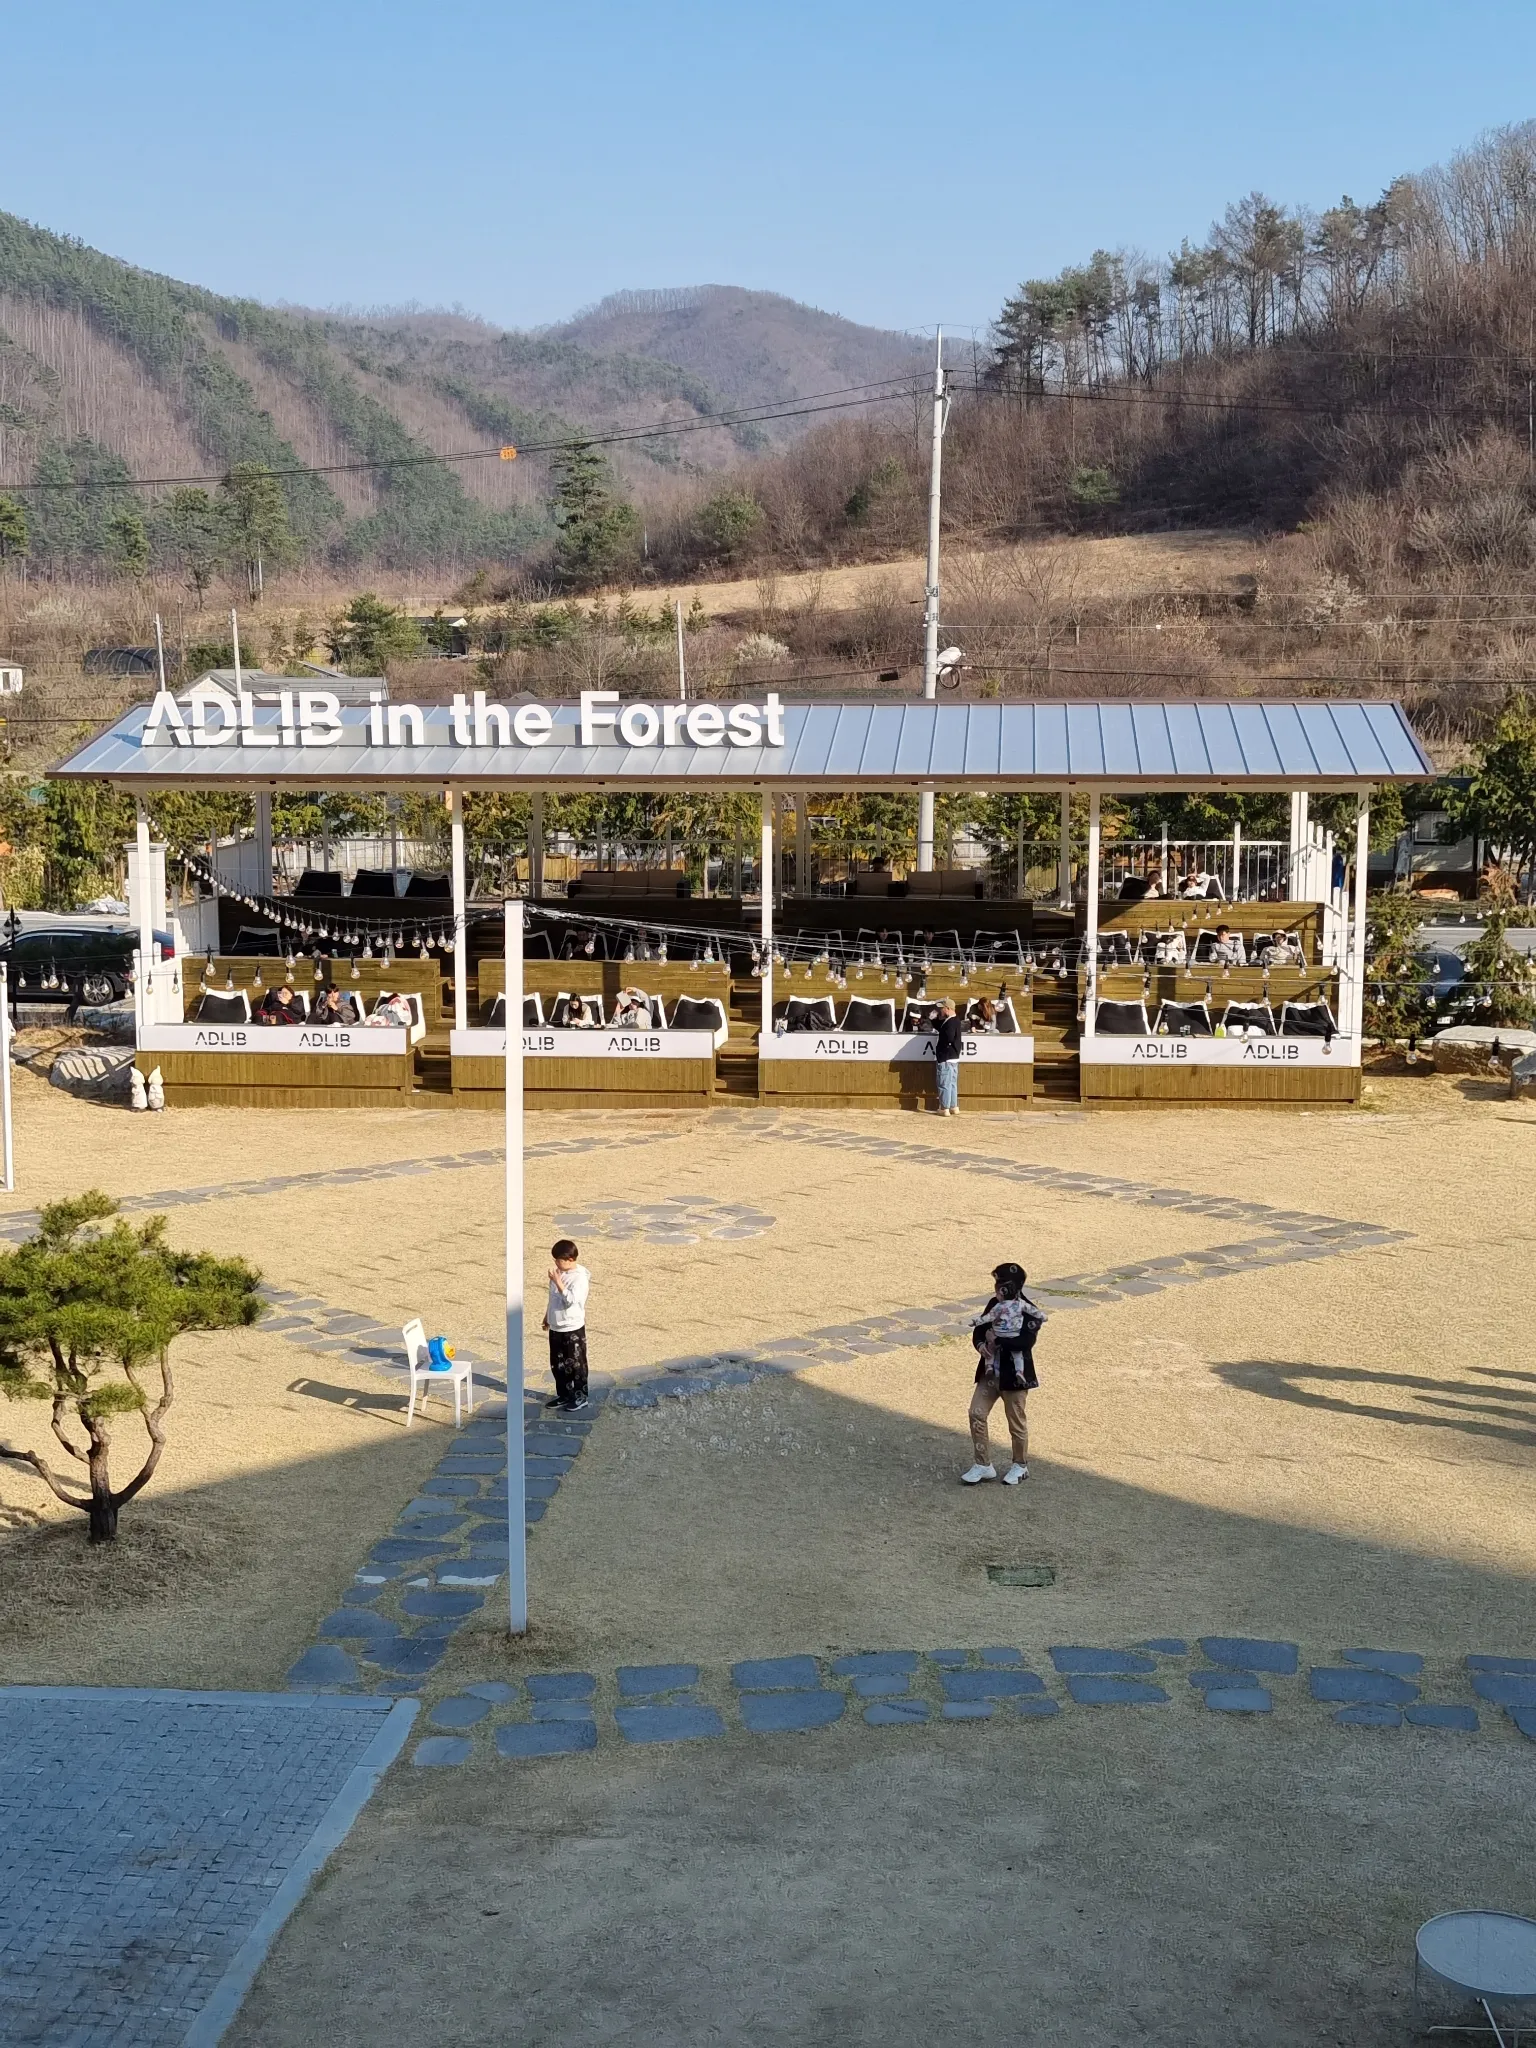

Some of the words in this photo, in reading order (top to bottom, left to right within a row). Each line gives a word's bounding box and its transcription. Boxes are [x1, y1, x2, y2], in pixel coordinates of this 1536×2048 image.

[142, 691, 344, 746] ADLIB
[369, 691, 424, 746] in
[449, 690, 553, 746] the
[580, 690, 785, 747] Forest
[195, 1031, 247, 1046] ADLIB
[299, 1032, 351, 1047] ADLIB
[502, 1036, 555, 1051] LIB
[608, 1037, 660, 1052] ADLIB
[815, 1039, 869, 1054] ADLIB
[922, 1041, 978, 1056] AIB
[1132, 1043, 1187, 1058] ADLIB
[1243, 1044, 1299, 1060] ADLIB
